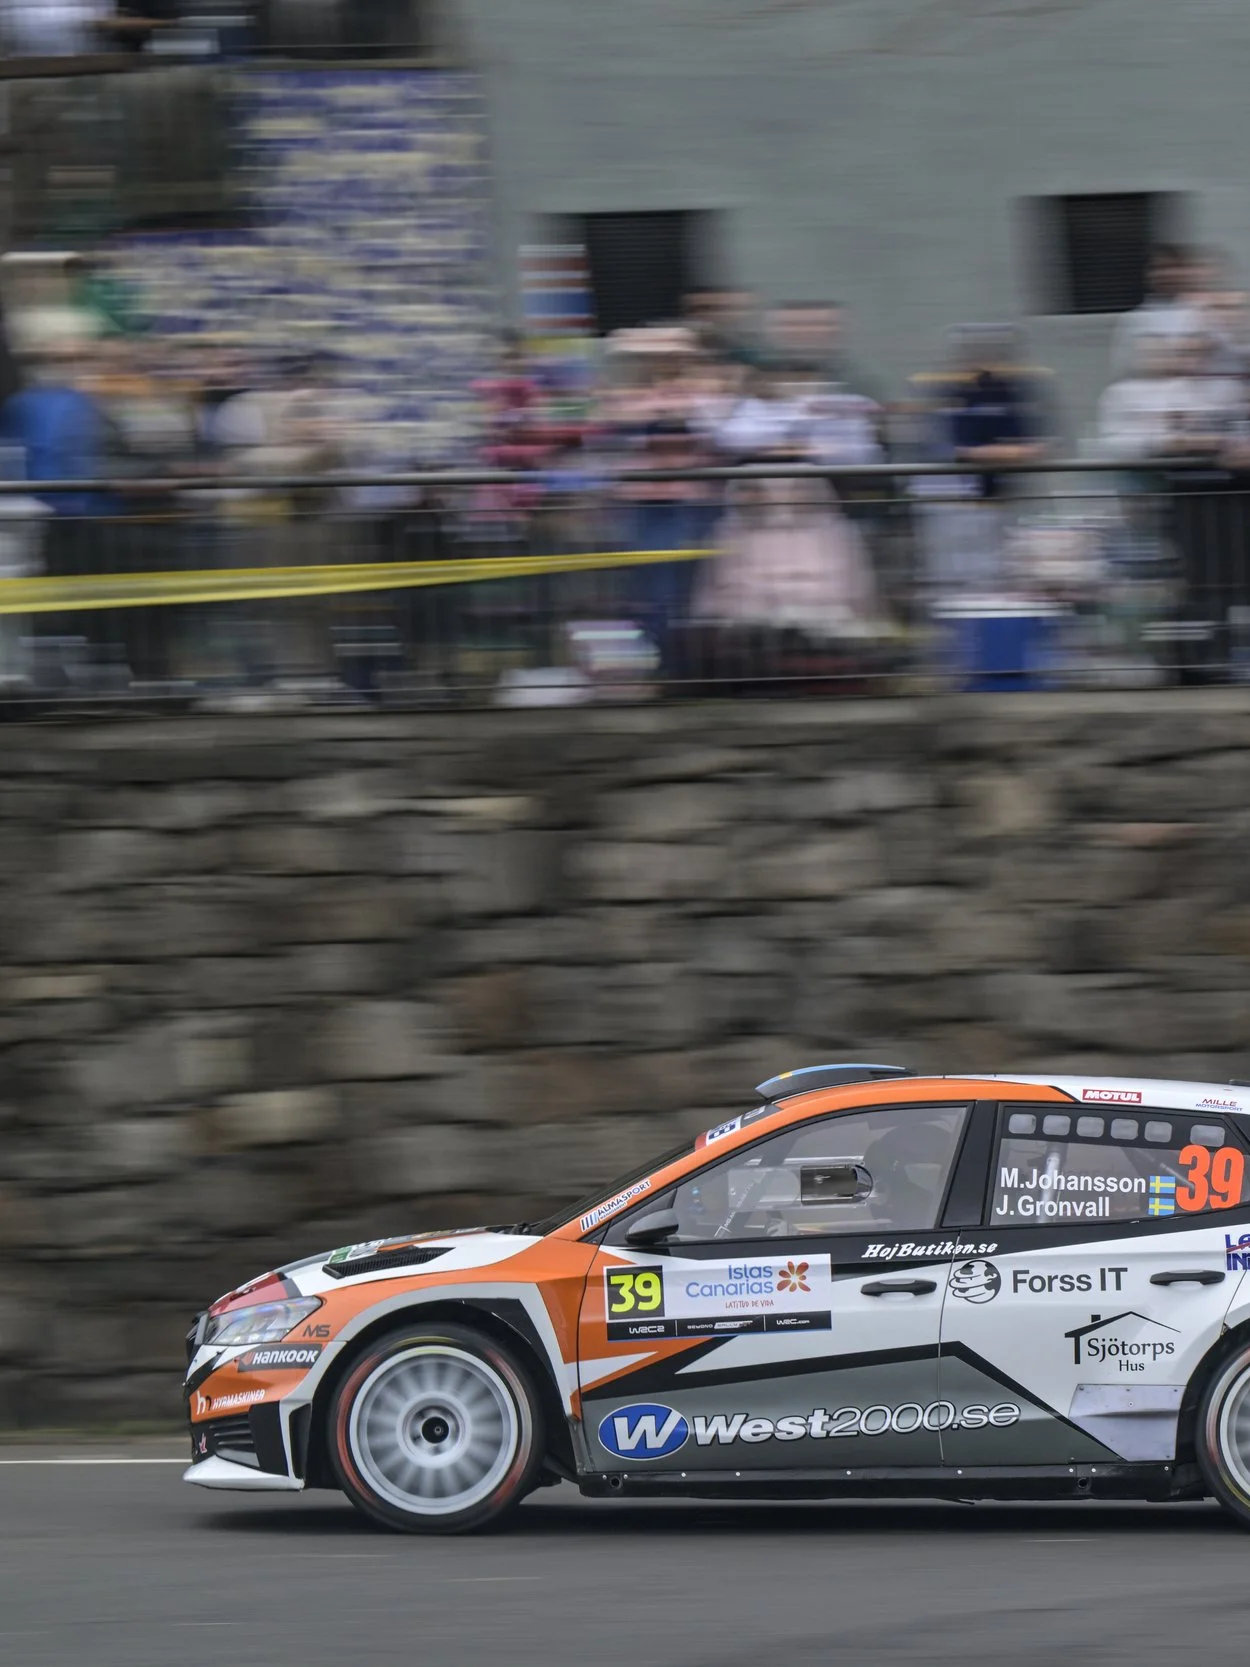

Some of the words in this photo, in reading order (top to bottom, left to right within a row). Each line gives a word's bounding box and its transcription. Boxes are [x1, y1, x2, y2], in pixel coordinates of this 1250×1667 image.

[1084, 1090, 1140, 1102] MOTUL
[1202, 1098, 1238, 1107] MILLE
[1001, 1167, 1147, 1194] M.Johansson
[1175, 1144, 1245, 1212] 39
[597, 1181, 650, 1217] ALMASPORT
[861, 1240, 999, 1261] HojButiken.se
[728, 1264, 773, 1280] Islas
[1013, 1269, 1092, 1293] Forss
[1101, 1267, 1128, 1292] IT
[610, 1272, 662, 1313] 39
[685, 1280, 774, 1298] Canarias
[303, 1324, 331, 1338] MS
[628, 1325, 665, 1335] WRC2
[1087, 1337, 1175, 1363] Sjötorps
[1119, 1359, 1145, 1372] Hus
[694, 1400, 1021, 1446] West2000.se
